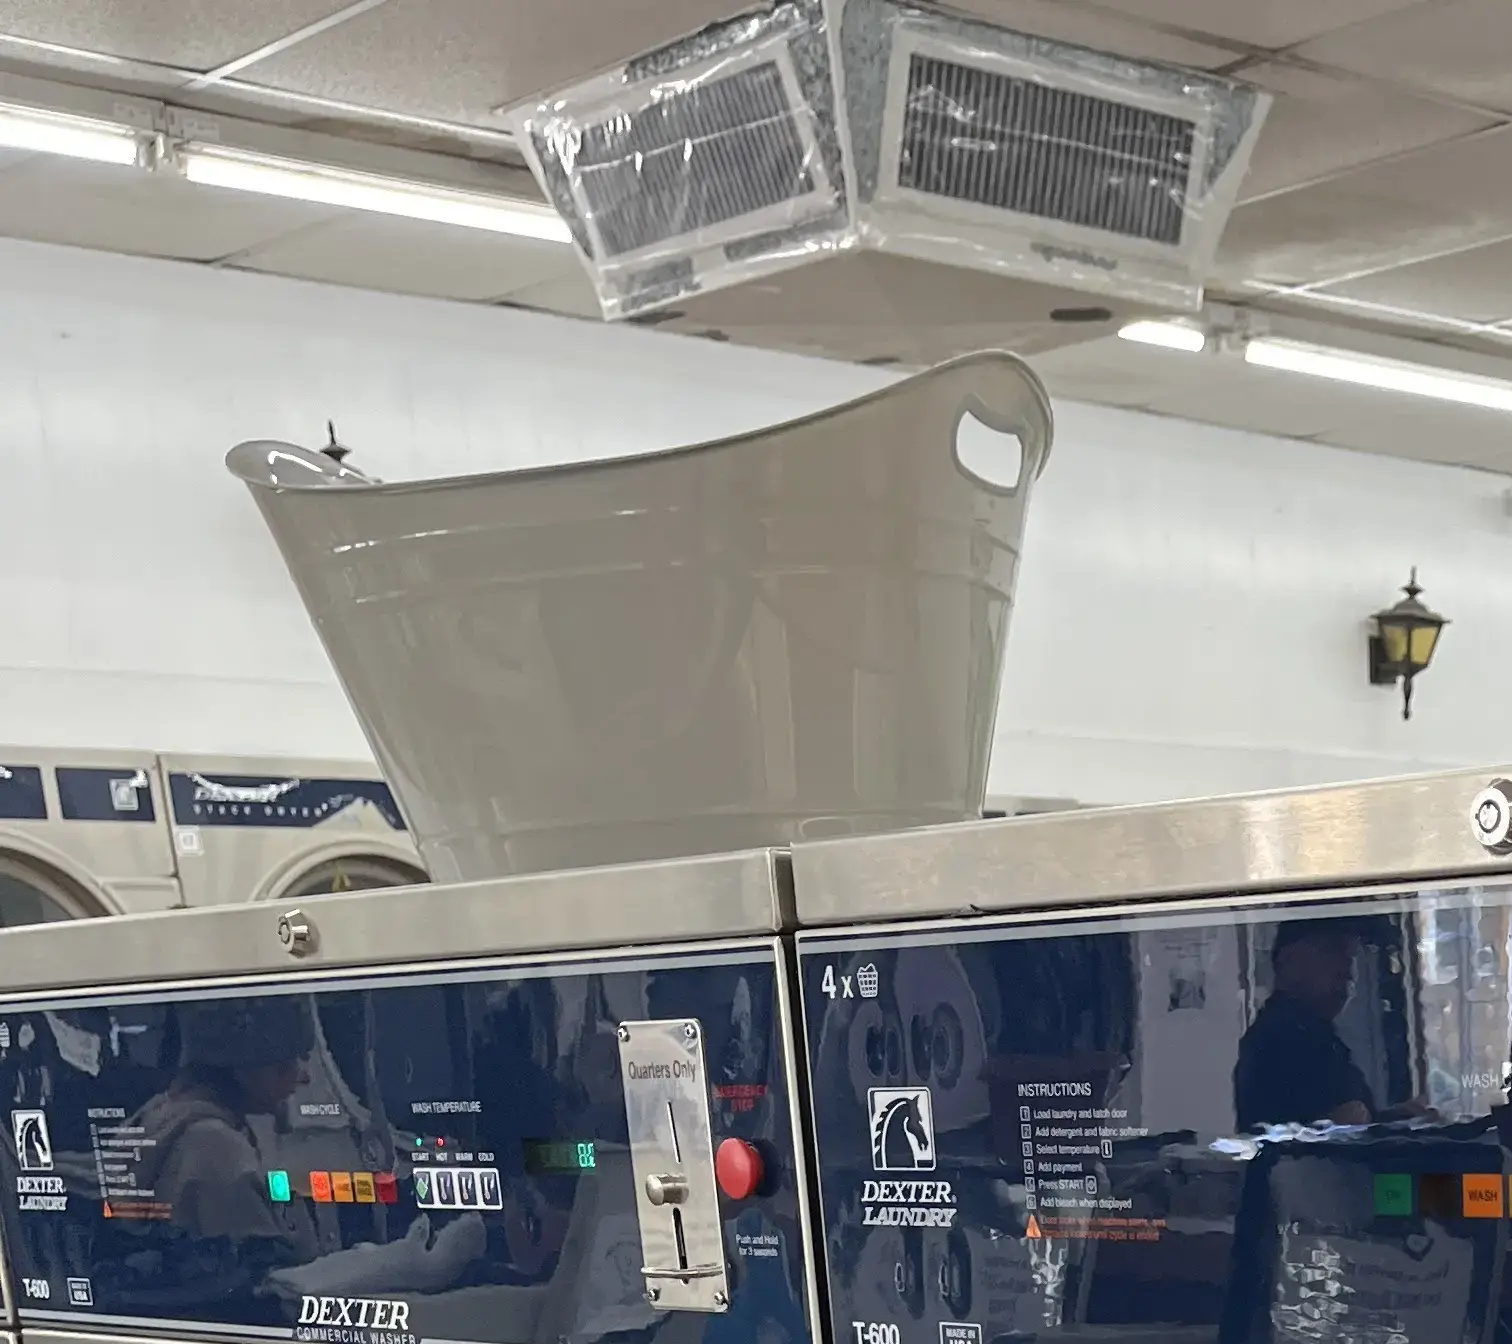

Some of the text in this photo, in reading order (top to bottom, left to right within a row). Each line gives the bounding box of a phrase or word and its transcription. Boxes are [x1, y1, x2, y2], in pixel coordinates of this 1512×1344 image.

[822, 965, 854, 999] 4 x
[628, 1060, 696, 1083] Quarters Only
[1461, 1073, 1499, 1088] WASH
[1018, 1082, 1092, 1097] INSTRUCTIONS
[1035, 1127, 1049, 1136] Add
[1084, 1127, 1097, 1136] and
[1038, 1162, 1051, 1172] Add
[16, 1176, 64, 1193] DEXTER
[1059, 1179, 1085, 1189] START
[861, 1181, 952, 1203] DEXTER
[1467, 1190, 1498, 1201] WASH
[1040, 1197, 1054, 1207] Add
[862, 1206, 957, 1227] LAUNDRY
[298, 1295, 409, 1330] DEXTER
[296, 1326, 367, 1344] COMMERCIAL
[945, 1328, 967, 1339] MADE
